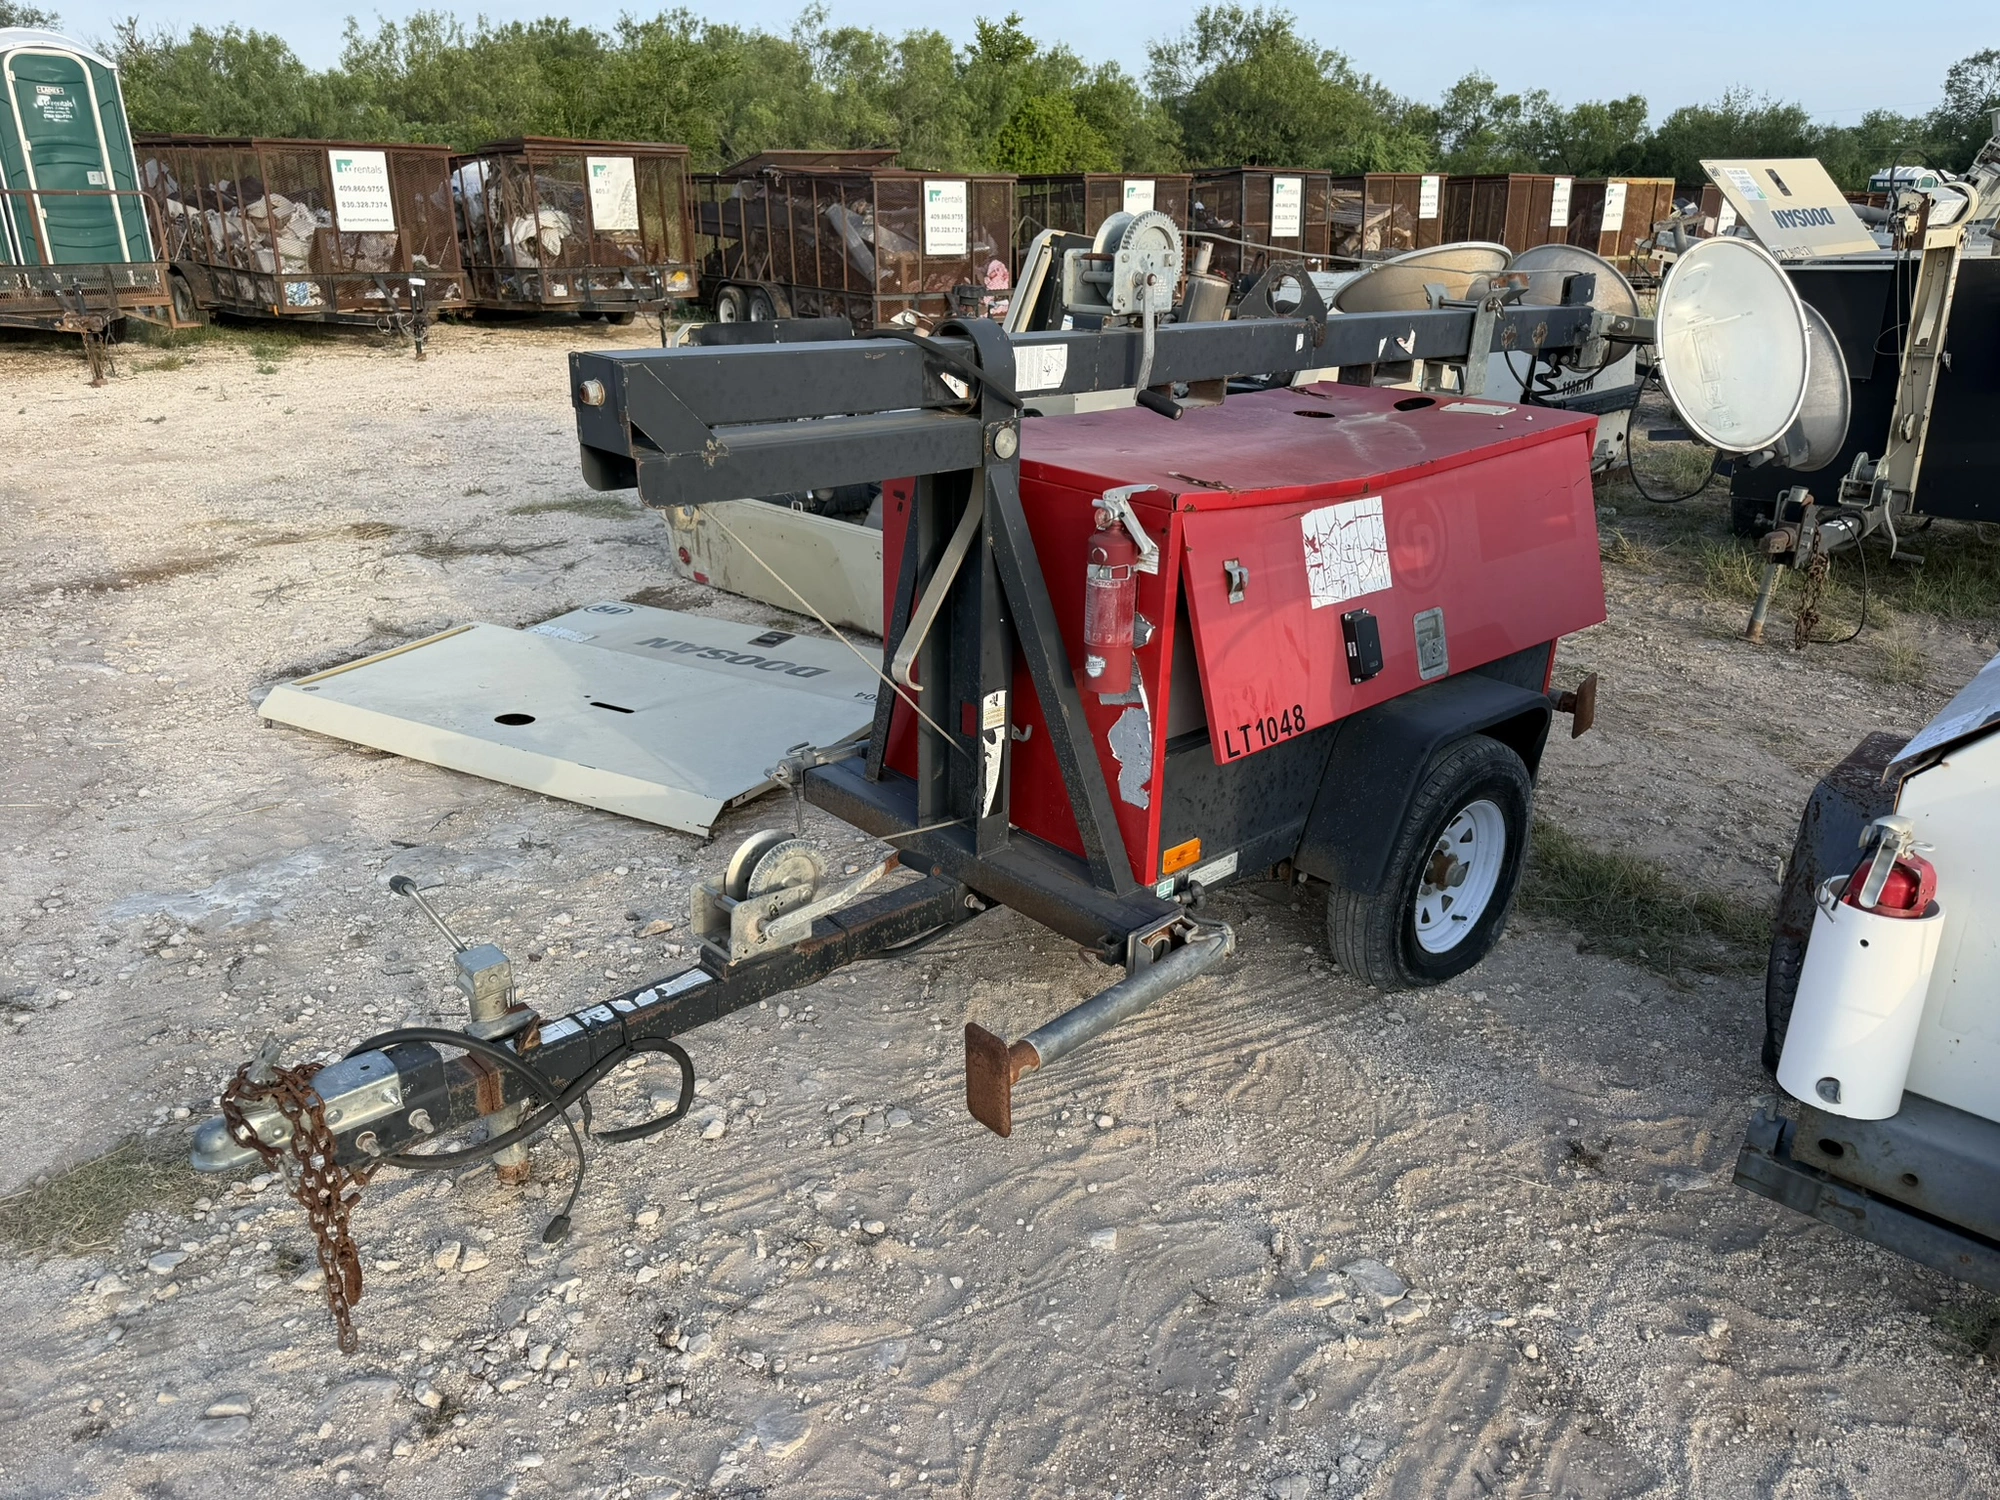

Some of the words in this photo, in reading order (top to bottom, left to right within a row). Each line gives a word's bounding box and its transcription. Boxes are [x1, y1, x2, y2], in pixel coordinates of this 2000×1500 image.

[354, 166, 383, 174] rentals
[942, 195, 963, 204] rentals
[1771, 207, 1836, 229] DOOSAN
[635, 636, 831, 678] DOOSAN
[854, 691, 878, 702] 04
[1224, 703, 1306, 759] LT1048
